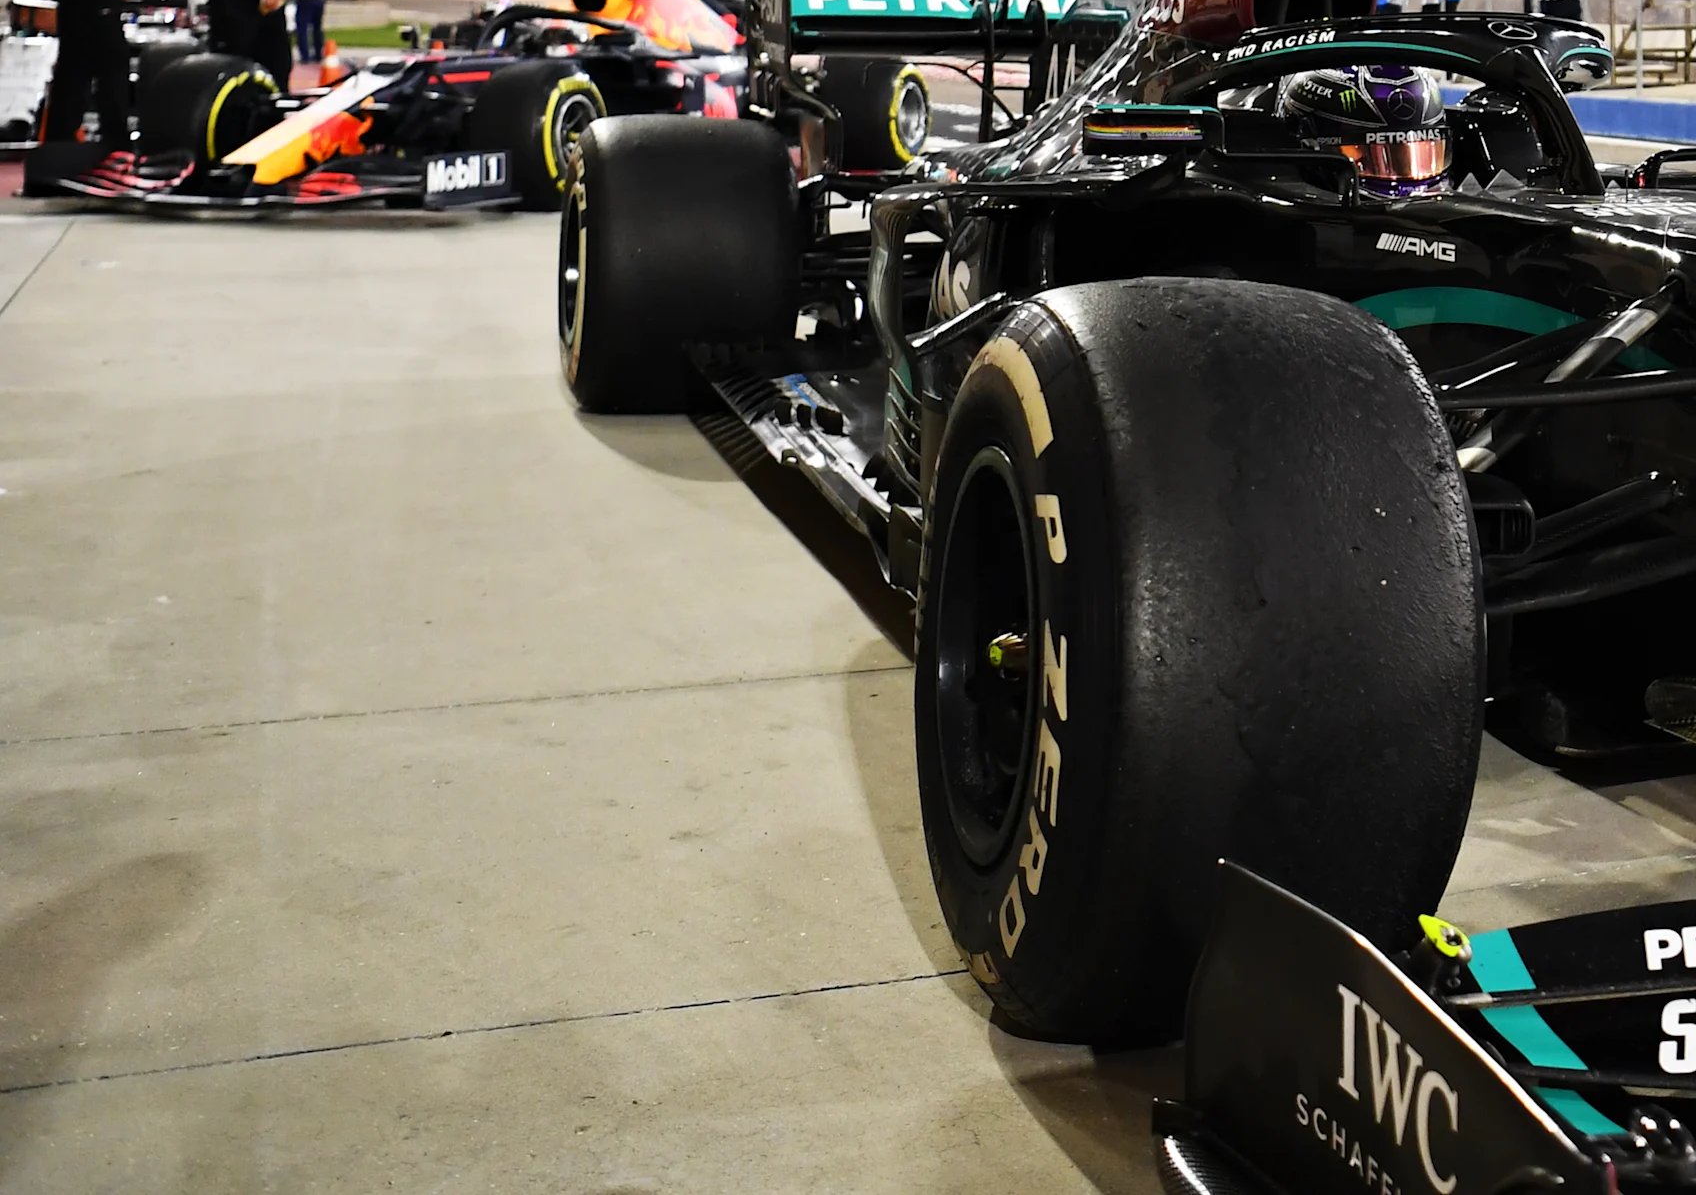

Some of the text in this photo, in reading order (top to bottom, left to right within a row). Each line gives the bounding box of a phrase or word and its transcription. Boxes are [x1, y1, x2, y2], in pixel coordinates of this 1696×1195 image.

[1227, 30, 1336, 61] END RACISM
[1366, 128, 1441, 144] PETRONAS
[427, 155, 480, 193] Mobil
[1402, 236, 1456, 262] AMG
[1035, 494, 1068, 564] P
[1338, 983, 1459, 1194] IWC
